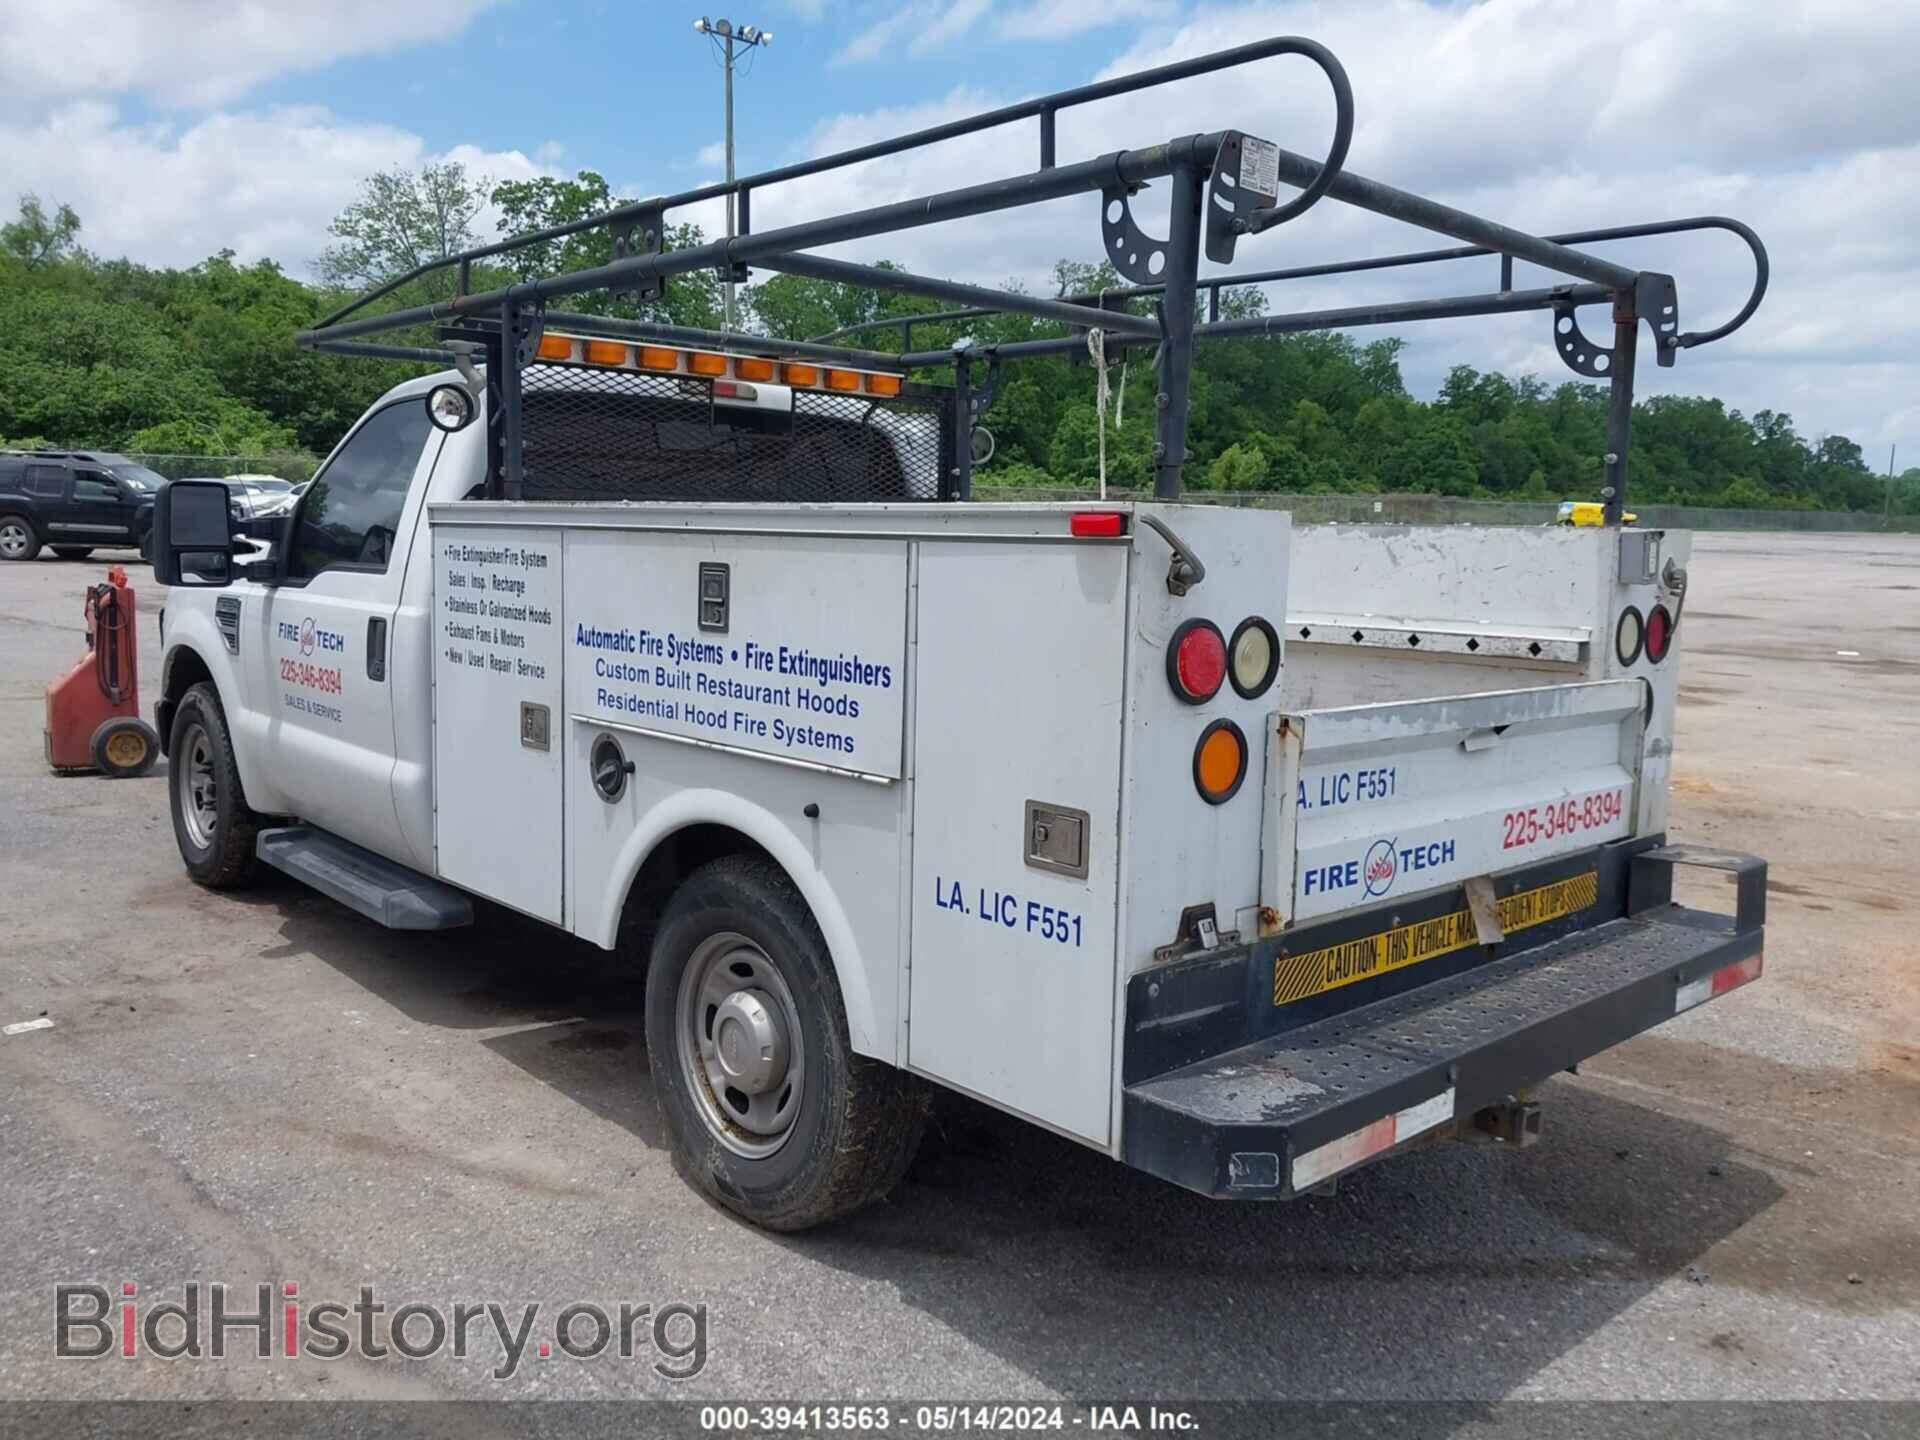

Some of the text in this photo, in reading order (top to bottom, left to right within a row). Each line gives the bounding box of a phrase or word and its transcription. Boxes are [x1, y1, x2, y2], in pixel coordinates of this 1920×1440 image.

[448, 545, 461, 561] Fire
[520, 549, 548, 570] System
[448, 570, 466, 587] Sales
[492, 574, 525, 597] Recharge
[448, 596, 551, 625] Stainless Or Galvanized Hoods
[278, 622, 344, 652] FIRE TECH
[448, 621, 525, 648] Exhaust Fans & Motors
[449, 647, 545, 679] New Used Repair Service
[576, 623, 891, 688] Automatic Fire Systems Fire Extinguishers
[280, 657, 342, 695] 225-346-8394
[595, 657, 860, 718] Custom Built Restaurant Hoods
[312, 702, 342, 722] SERVICE
[597, 688, 854, 753] Residential Hood Fire Systems
[1320, 773, 1350, 806] LIC
[1356, 767, 1396, 801] F551
[1503, 789, 1622, 849] 225-346-8394
[1304, 839, 1455, 896] FIRE TECH
[936, 876, 1082, 947] LA. LIC F551
[1385, 929, 1409, 966] THIS
[1413, 916, 1456, 957] VEHICLE
